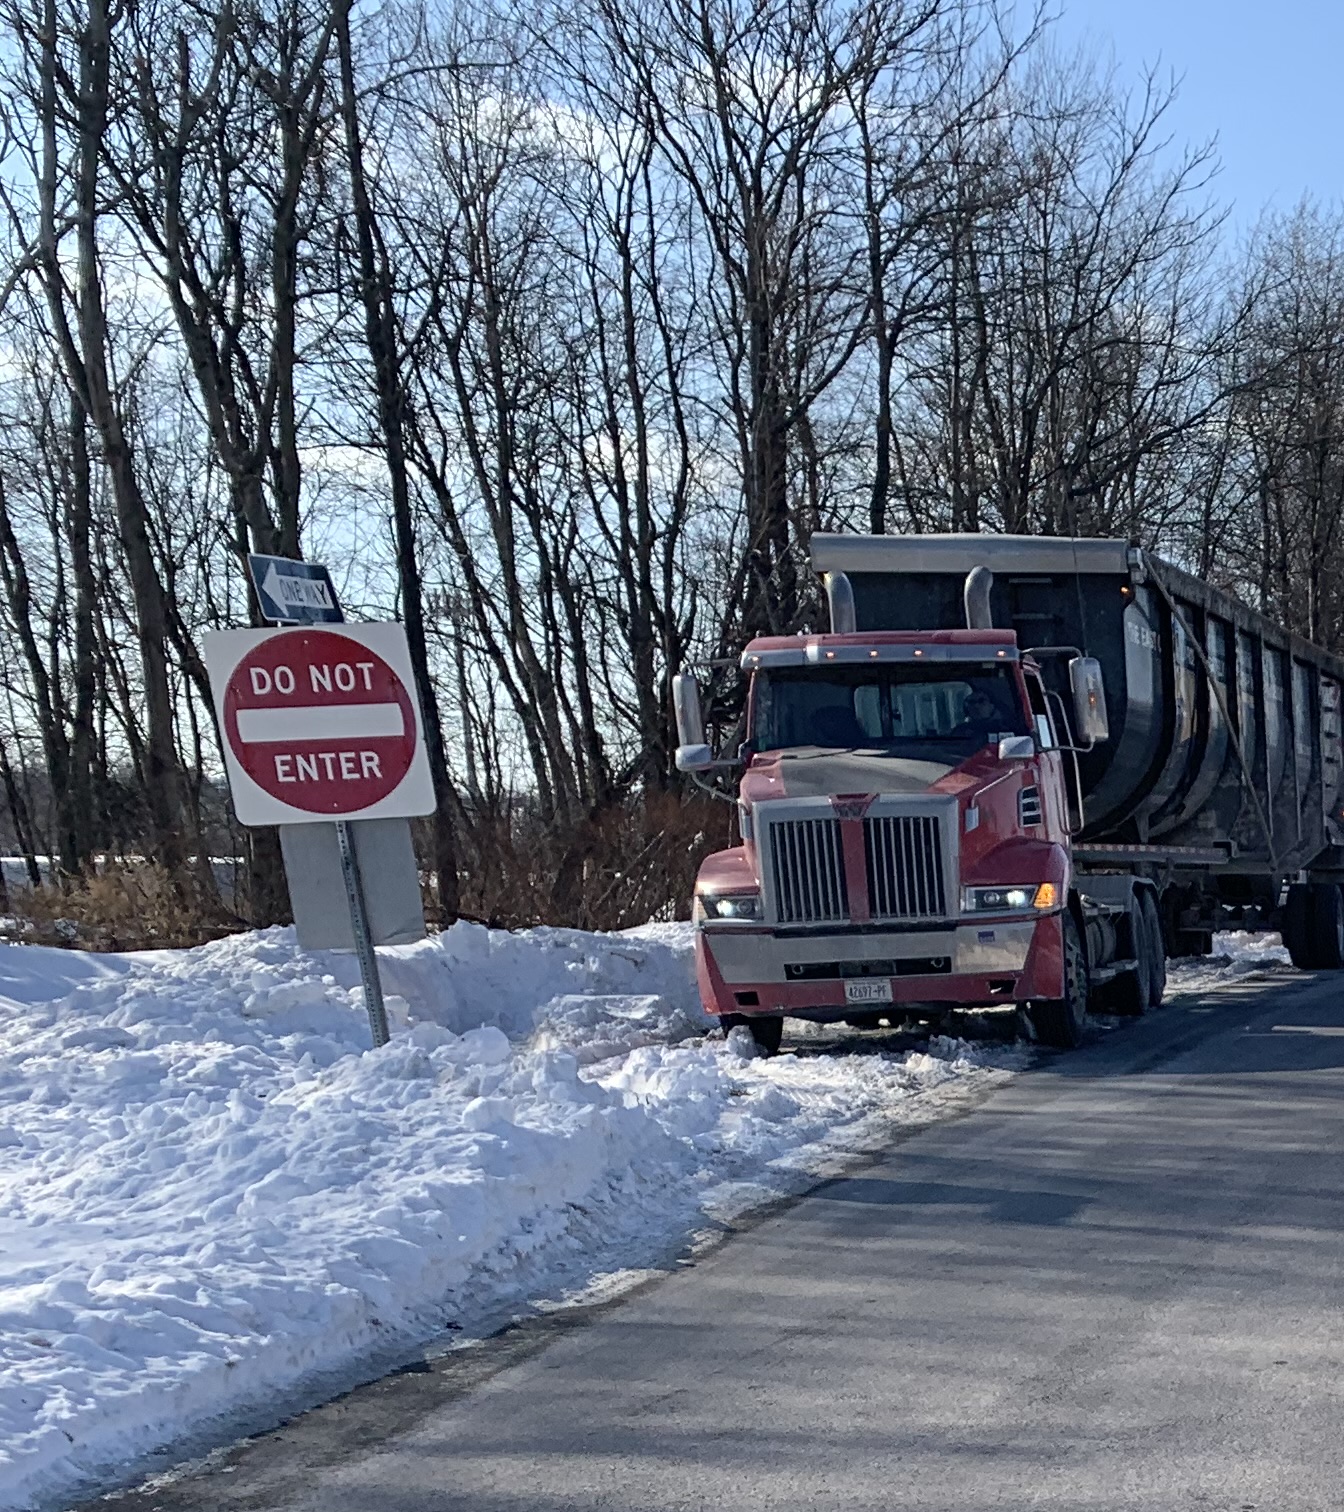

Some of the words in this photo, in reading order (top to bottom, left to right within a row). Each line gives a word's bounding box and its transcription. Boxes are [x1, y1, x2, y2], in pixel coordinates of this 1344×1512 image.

[280, 579, 304, 603] ONE
[305, 583, 328, 606] WAY
[250, 665, 295, 695] DO
[309, 662, 374, 693] NOT
[274, 751, 382, 783] ENTER
